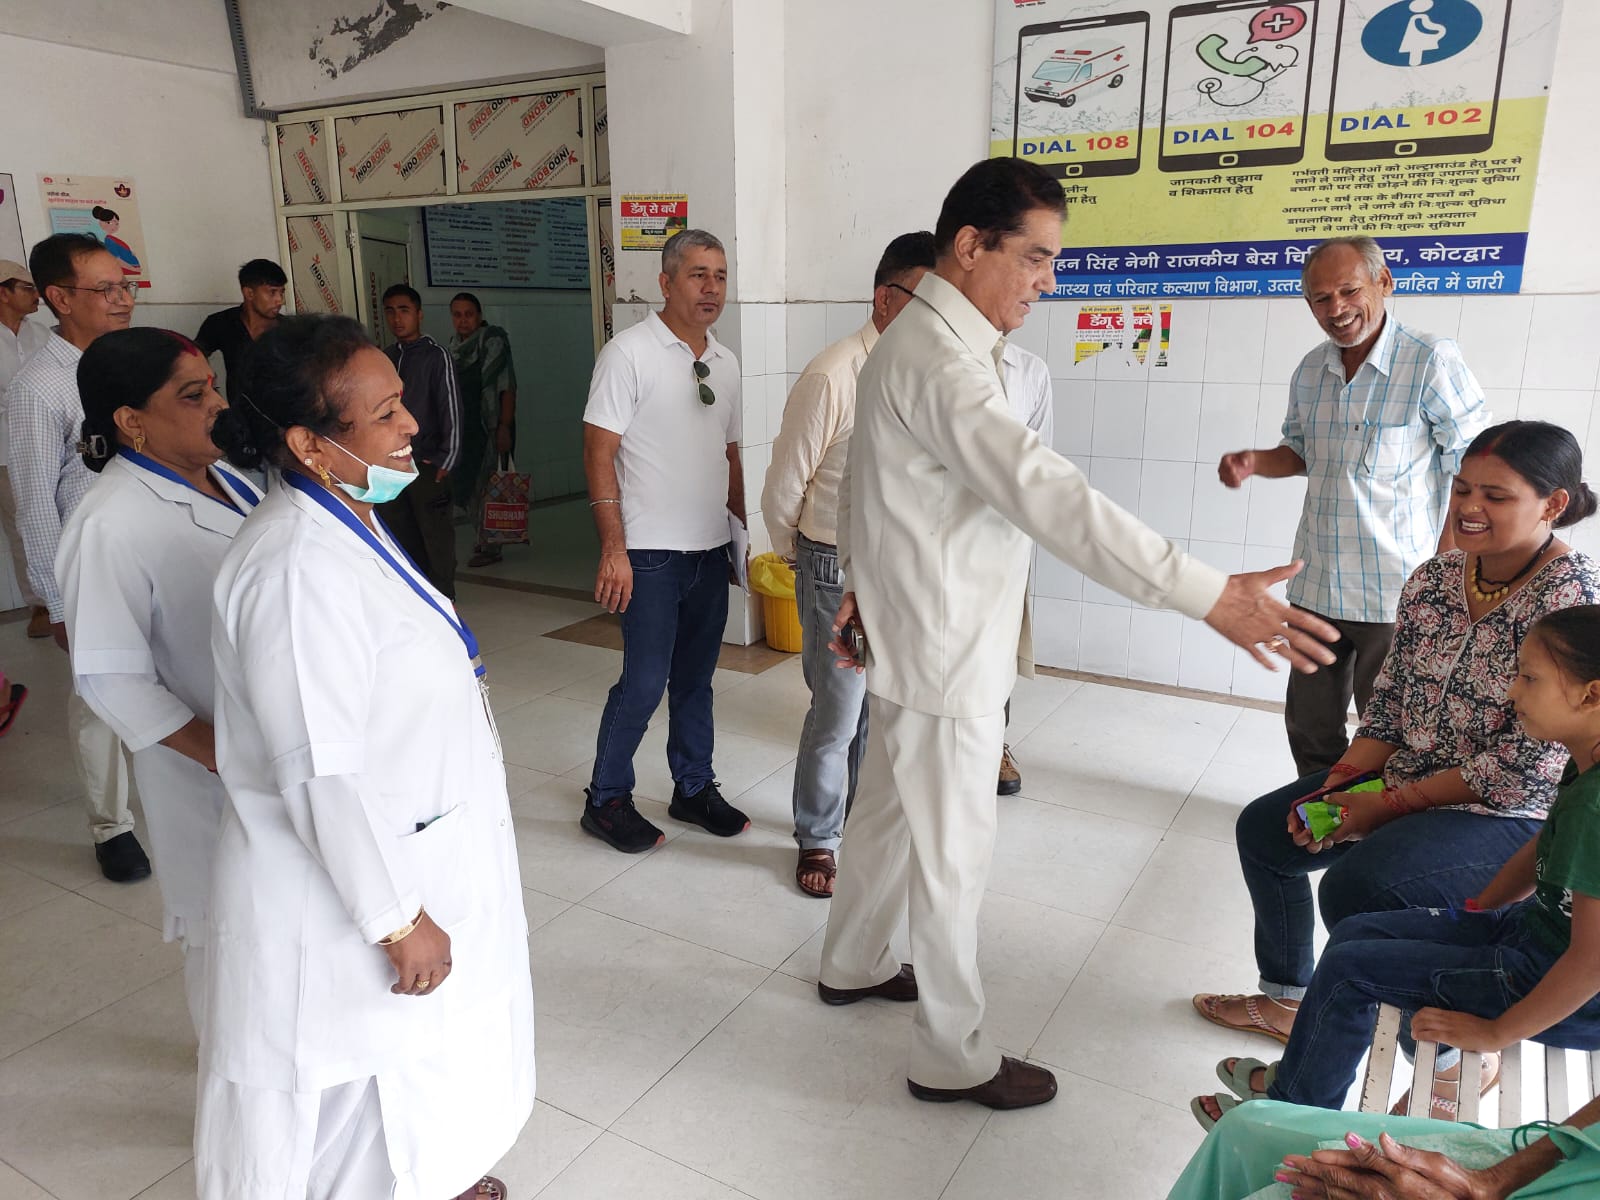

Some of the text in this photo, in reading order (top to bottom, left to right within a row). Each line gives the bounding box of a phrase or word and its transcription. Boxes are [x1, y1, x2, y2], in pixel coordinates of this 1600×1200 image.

[1340, 108, 1482, 132] DIAL 102
[1173, 122, 1294, 145] DIAL 104
[1022, 136, 1129, 155] DIAL 108
[355, 139, 391, 181] INDOBOND
[400, 134, 438, 178] INDOBOND
[1292, 168, 1329, 176] गर्भवती
[1385, 163, 1400, 171] को
[1470, 159, 1487, 168] हेतु
[1170, 174, 1263, 185] जानकारी सुझाव
[1182, 187, 1231, 196] शिकायत
[1235, 184, 1254, 194] हेतु
[649, 203, 658, 213] से
[1427, 211, 1477, 219] अस्पताल
[1086, 253, 1120, 271] सिंह
[1125, 251, 1160, 269] नेगी
[1166, 249, 1239, 268] राजकीय
[1245, 247, 1279, 265] बेस
[1419, 242, 1503, 263] कोटद्वार
[1094, 280, 1112, 296] एवं
[1116, 278, 1159, 295] परिवार
[1163, 281, 1210, 294] कल्याण
[1215, 275, 1261, 295] विभाग,
[1445, 271, 1461, 290] में
[1466, 270, 1505, 290] जारी
